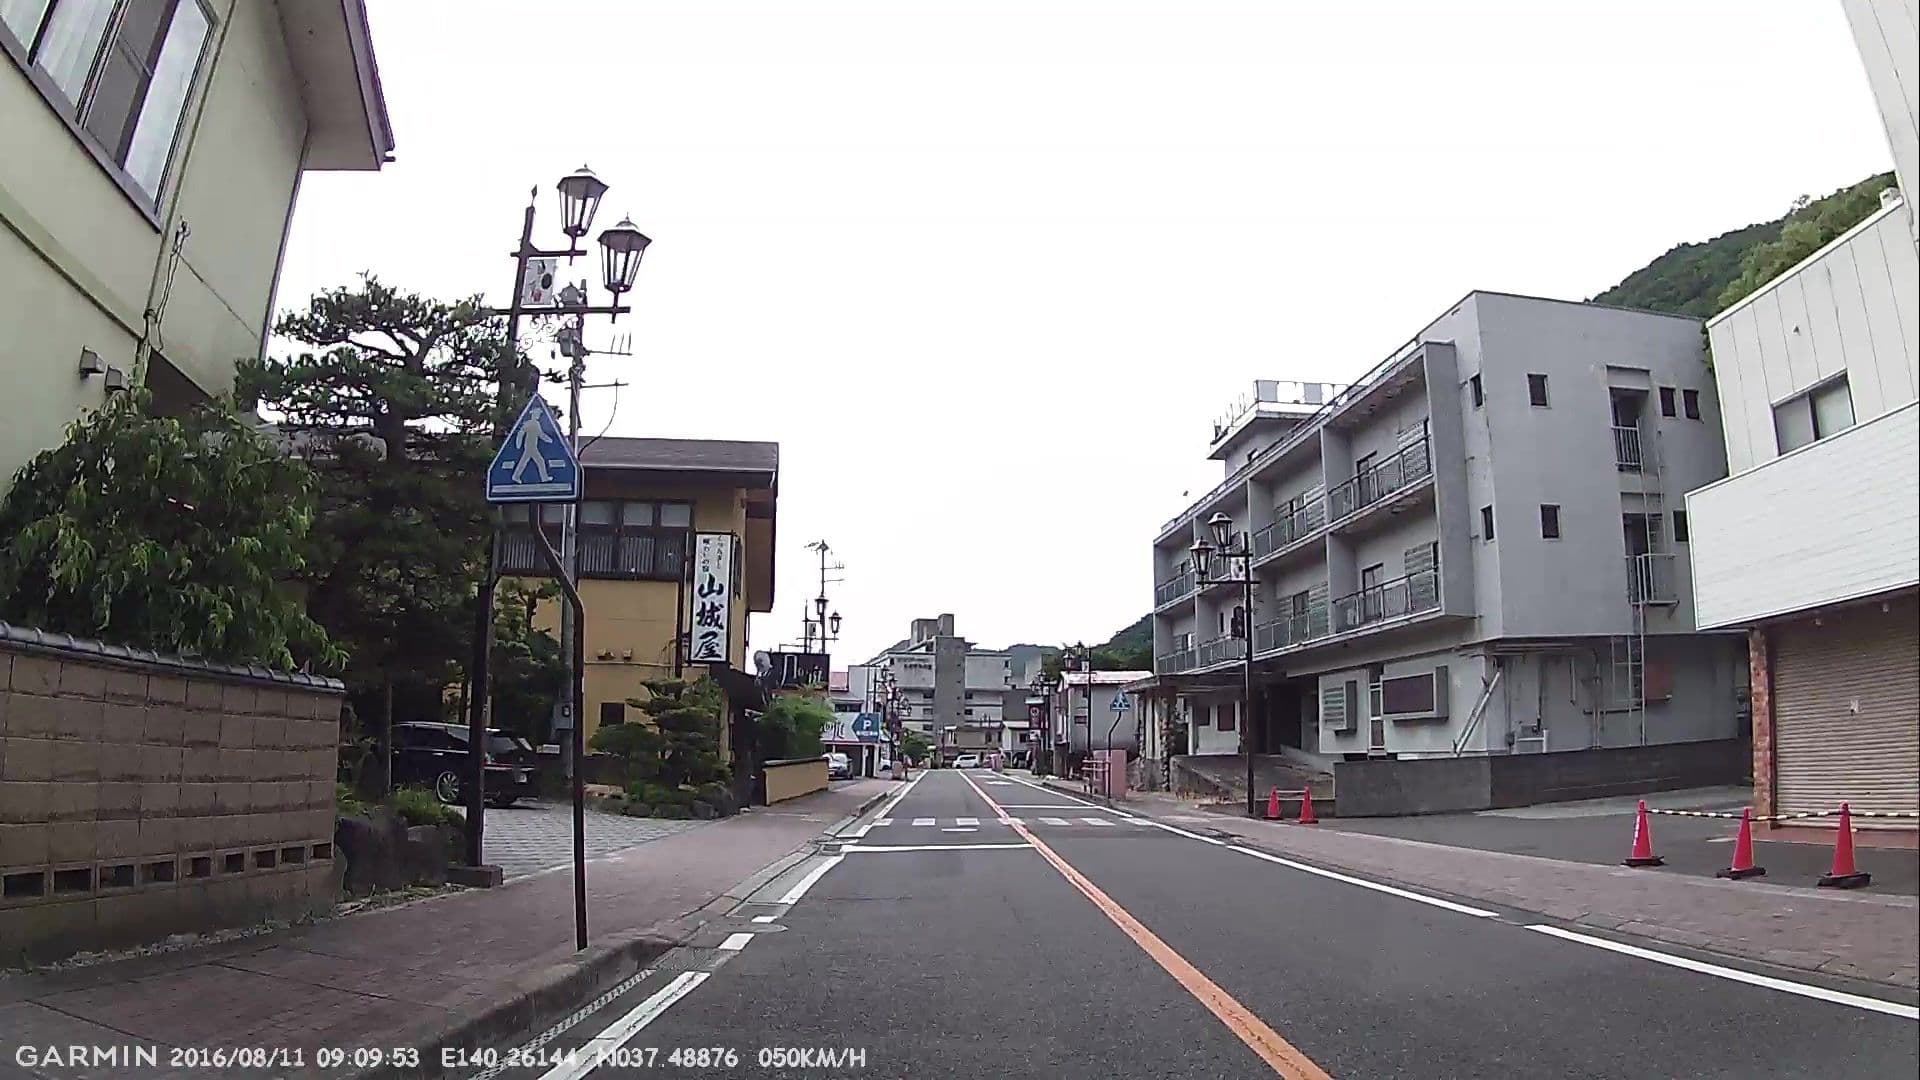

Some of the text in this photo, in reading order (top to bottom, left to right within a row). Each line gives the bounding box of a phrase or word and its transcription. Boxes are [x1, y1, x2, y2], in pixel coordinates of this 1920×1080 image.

[693, 574, 725, 660] 山城屋
[863, 719, 872, 731] P
